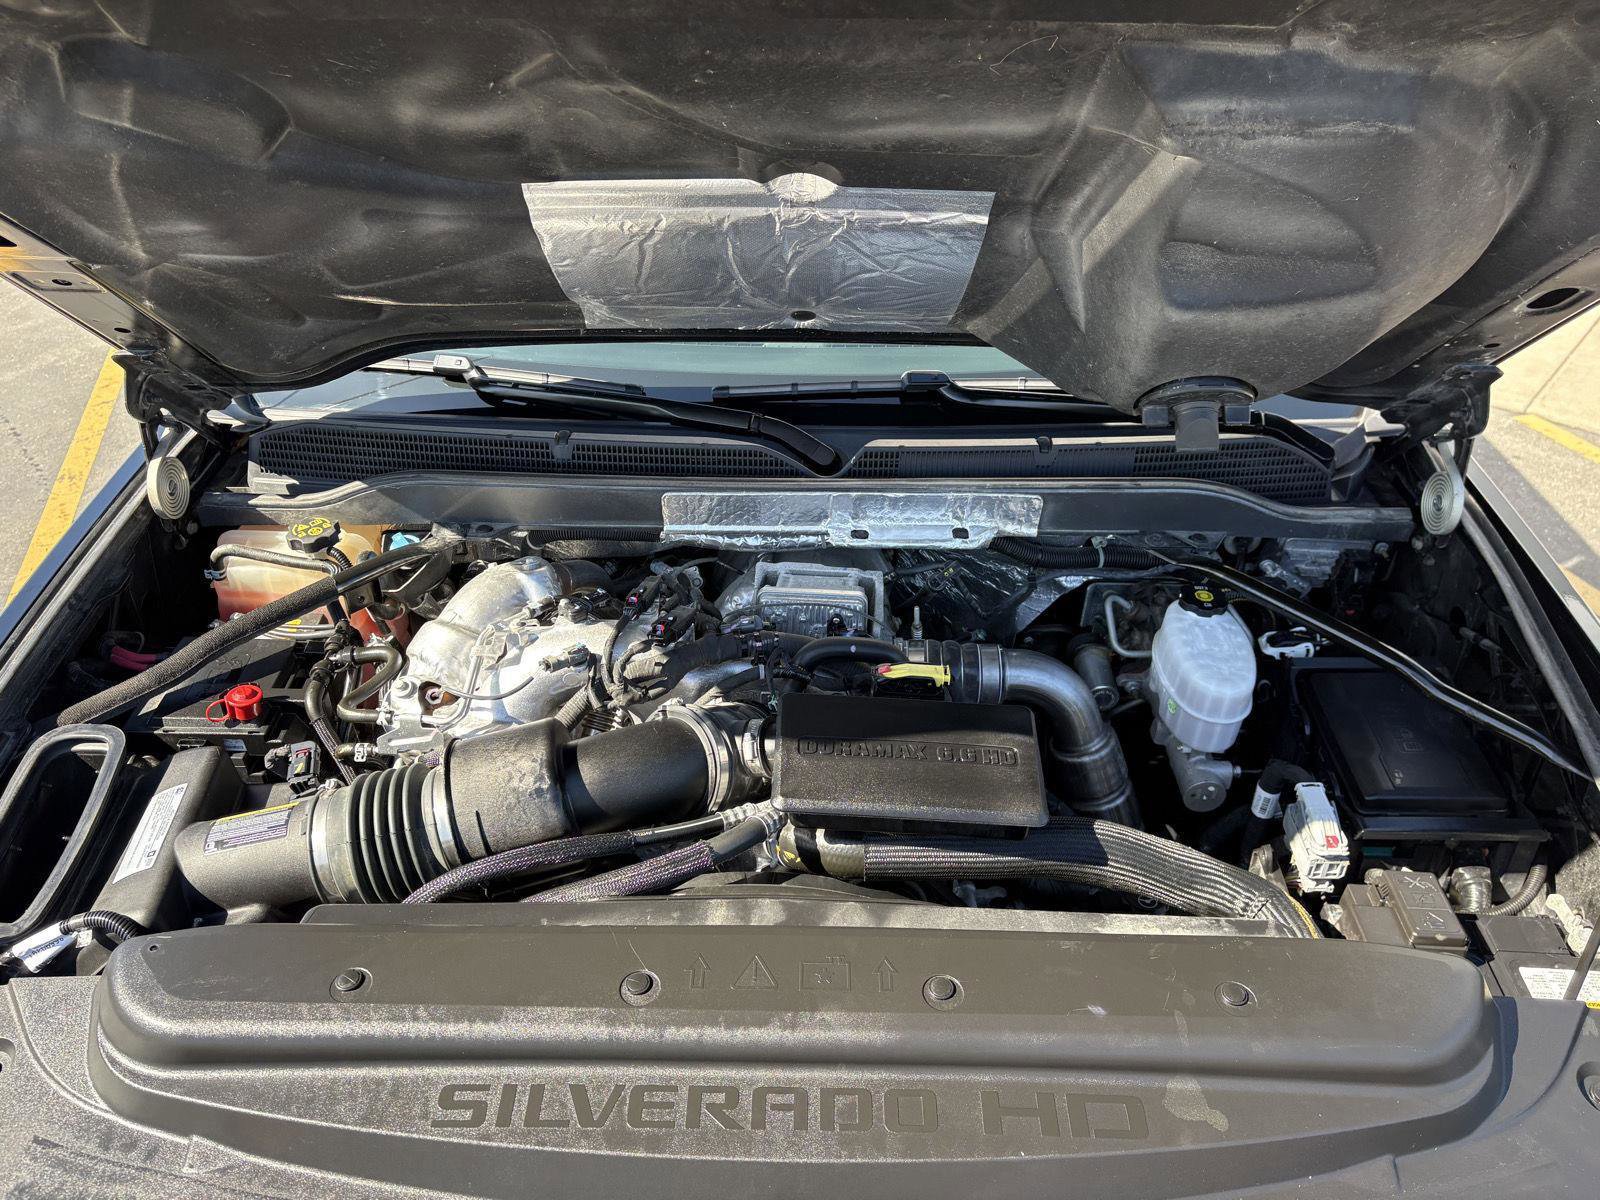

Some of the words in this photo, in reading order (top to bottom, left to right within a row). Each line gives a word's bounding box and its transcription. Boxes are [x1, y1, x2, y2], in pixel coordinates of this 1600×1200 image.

[802, 738, 927, 760] DURAMAX
[982, 748, 1018, 766] HD
[430, 1084, 938, 1134] SILVERADO
[981, 1089, 1149, 1139] HD
